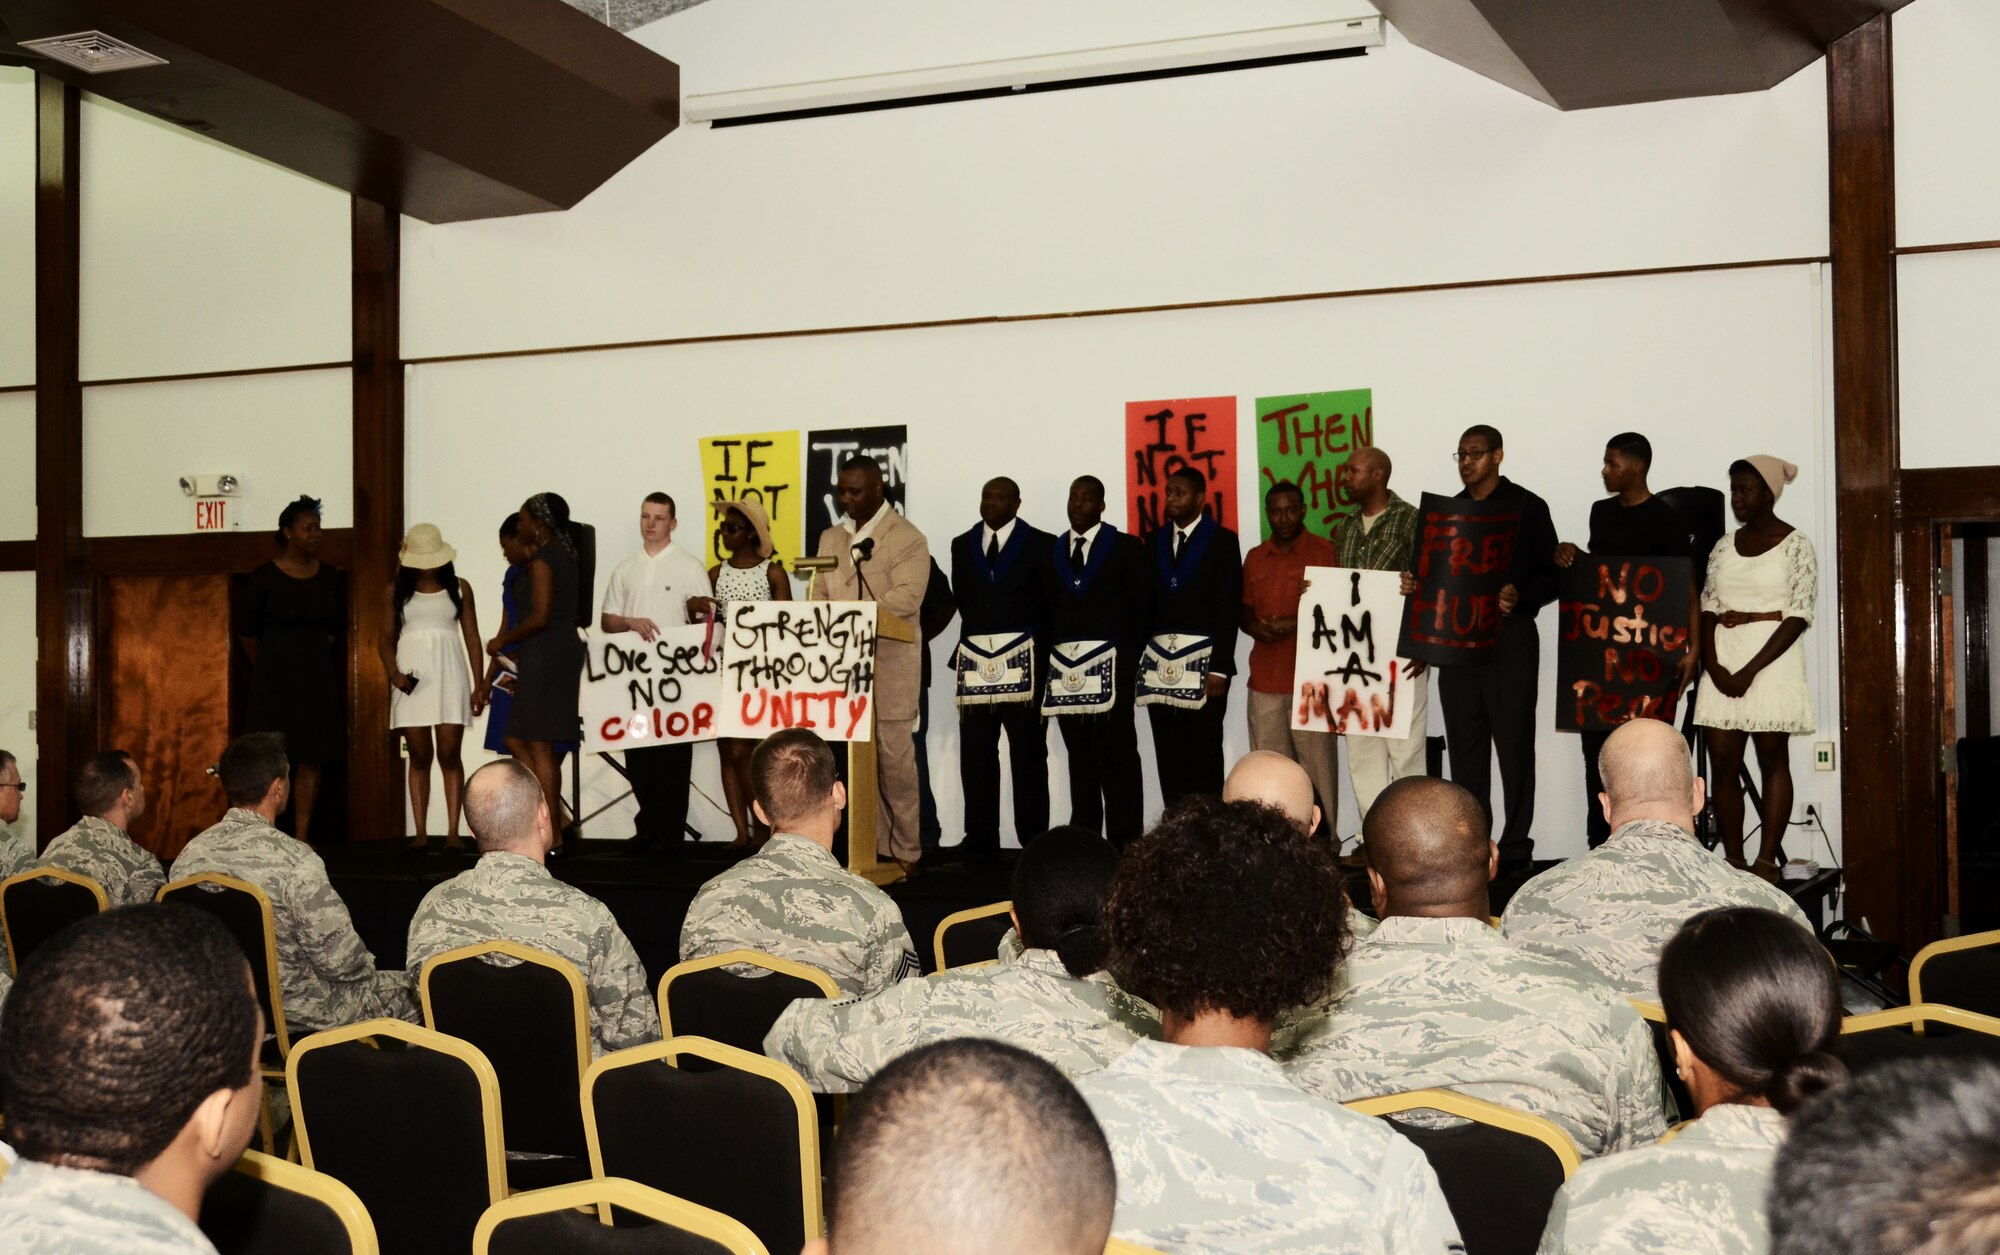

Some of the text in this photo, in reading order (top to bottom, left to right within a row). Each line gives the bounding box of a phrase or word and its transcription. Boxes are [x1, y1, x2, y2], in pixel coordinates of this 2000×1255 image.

[1145, 408, 1207, 452] IF
[1261, 403, 1373, 457] THEN
[712, 440, 774, 483] IF
[811, 441, 906, 489] TEN
[196, 501, 226, 529] EXIT
[1350, 571, 1361, 607] I
[1599, 562, 1664, 604] NO
[732, 603, 875, 658] STRENGTH
[1312, 603, 1375, 664] AM
[728, 651, 873, 693] THROUGH
[1324, 651, 1382, 687] A
[1605, 646, 1663, 684] NO
[628, 677, 682, 710] NO
